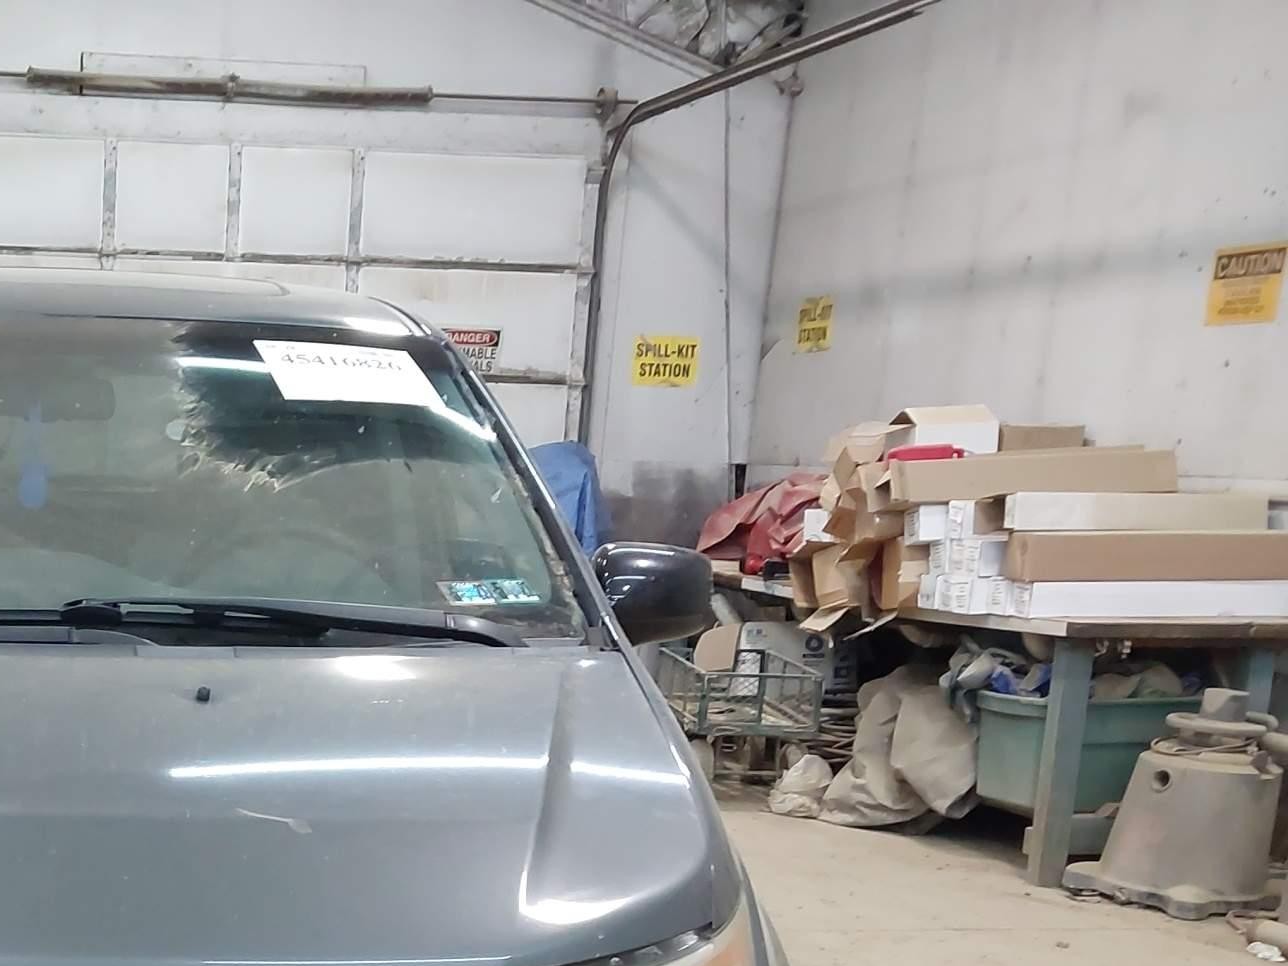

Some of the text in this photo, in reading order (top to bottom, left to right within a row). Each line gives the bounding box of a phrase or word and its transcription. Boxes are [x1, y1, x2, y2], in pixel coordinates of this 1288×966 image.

[1216, 250, 1284, 278] CAUTION
[636, 343, 697, 358] SPILL-KIT
[639, 362, 691, 378] STATION
